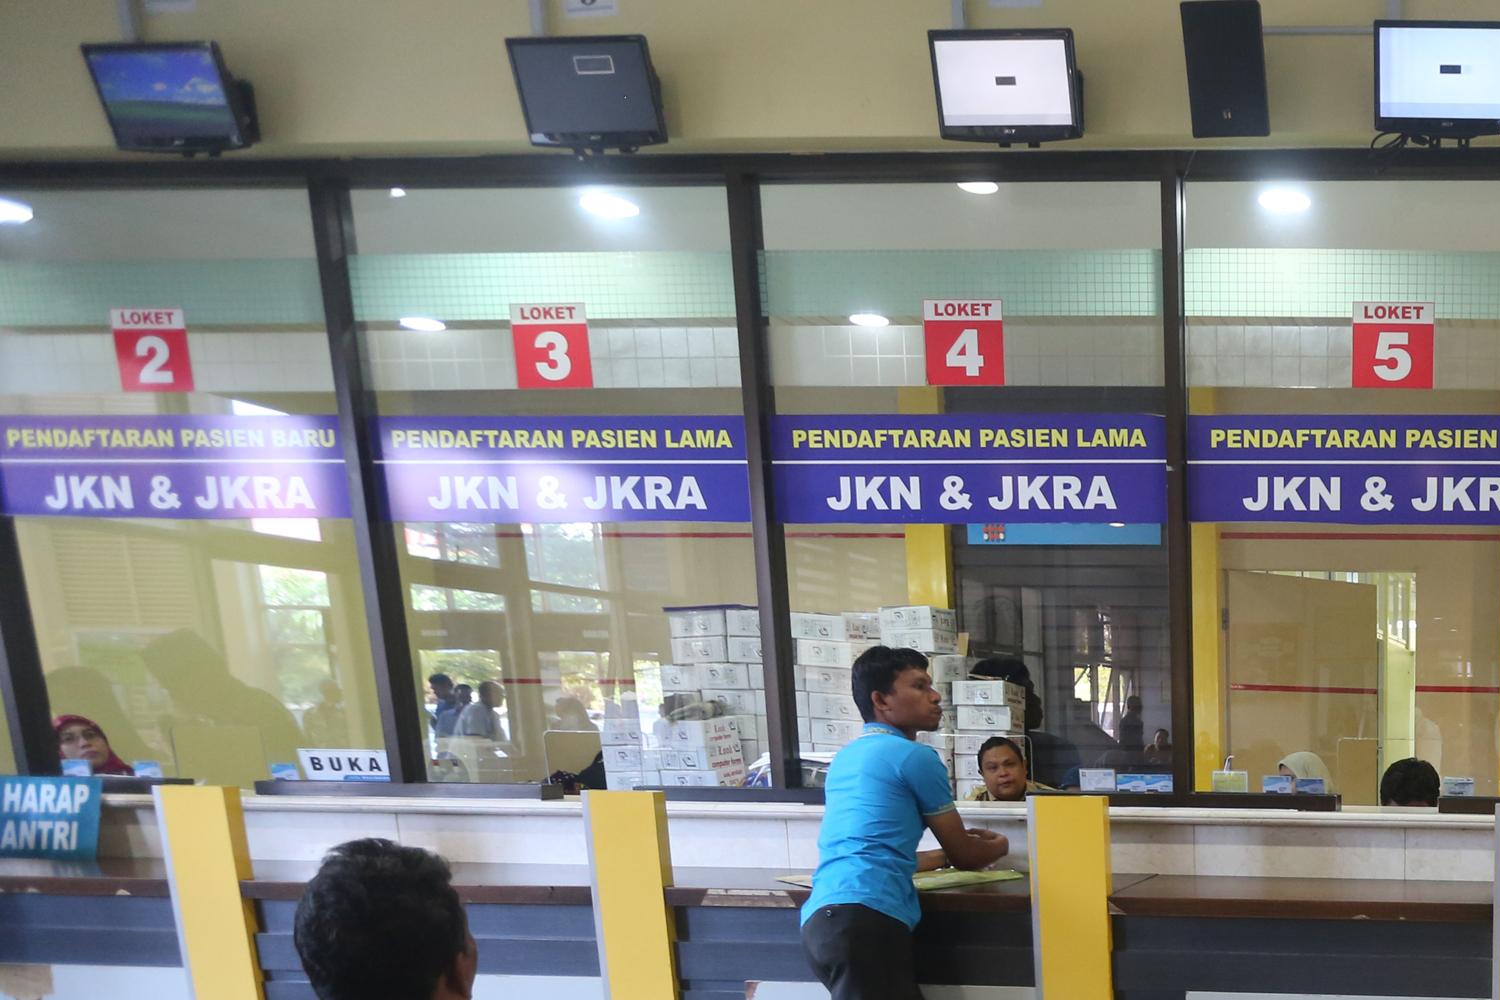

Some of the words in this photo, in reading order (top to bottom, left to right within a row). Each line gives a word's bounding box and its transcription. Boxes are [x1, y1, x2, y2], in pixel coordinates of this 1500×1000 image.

[120, 311, 174, 326] LOKET
[520, 306, 577, 321] LOKET
[934, 302, 992, 317] LOKET
[1364, 305, 1424, 320] LOKET
[134, 335, 174, 384] 2
[534, 330, 571, 381] 3
[945, 328, 984, 377] 4
[1373, 331, 1412, 382] 5
[6, 428, 177, 449] PENDAFTARAN
[180, 429, 265, 448] PASIEN
[270, 429, 336, 448] BARU
[391, 429, 565, 449] PENDAFTARAN
[571, 429, 658, 449] PASIEN
[664, 429, 733, 449] LAMA
[792, 428, 972, 449] PENDAFTARAN
[979, 428, 1069, 448] PASIEN
[1076, 428, 1147, 448] LAMA
[1210, 429, 1397, 449] PENDAFTARAN
[1405, 429, 1498, 449] PASIEN
[44, 475, 134, 511] JKN
[149, 475, 182, 511] &
[196, 474, 317, 511] JKRA
[428, 475, 518, 511] JKN
[536, 475, 569, 511] &
[582, 475, 708, 511] JKRA
[826, 476, 921, 511] JKN
[939, 475, 973, 511] &
[988, 475, 1117, 511] JKRA
[1242, 476, 1341, 512] JKN
[1360, 476, 1395, 512] &
[309, 756, 383, 772] BUKA
[3, 783, 90, 814] HARAP
[0, 820, 78, 850] ANTRI
